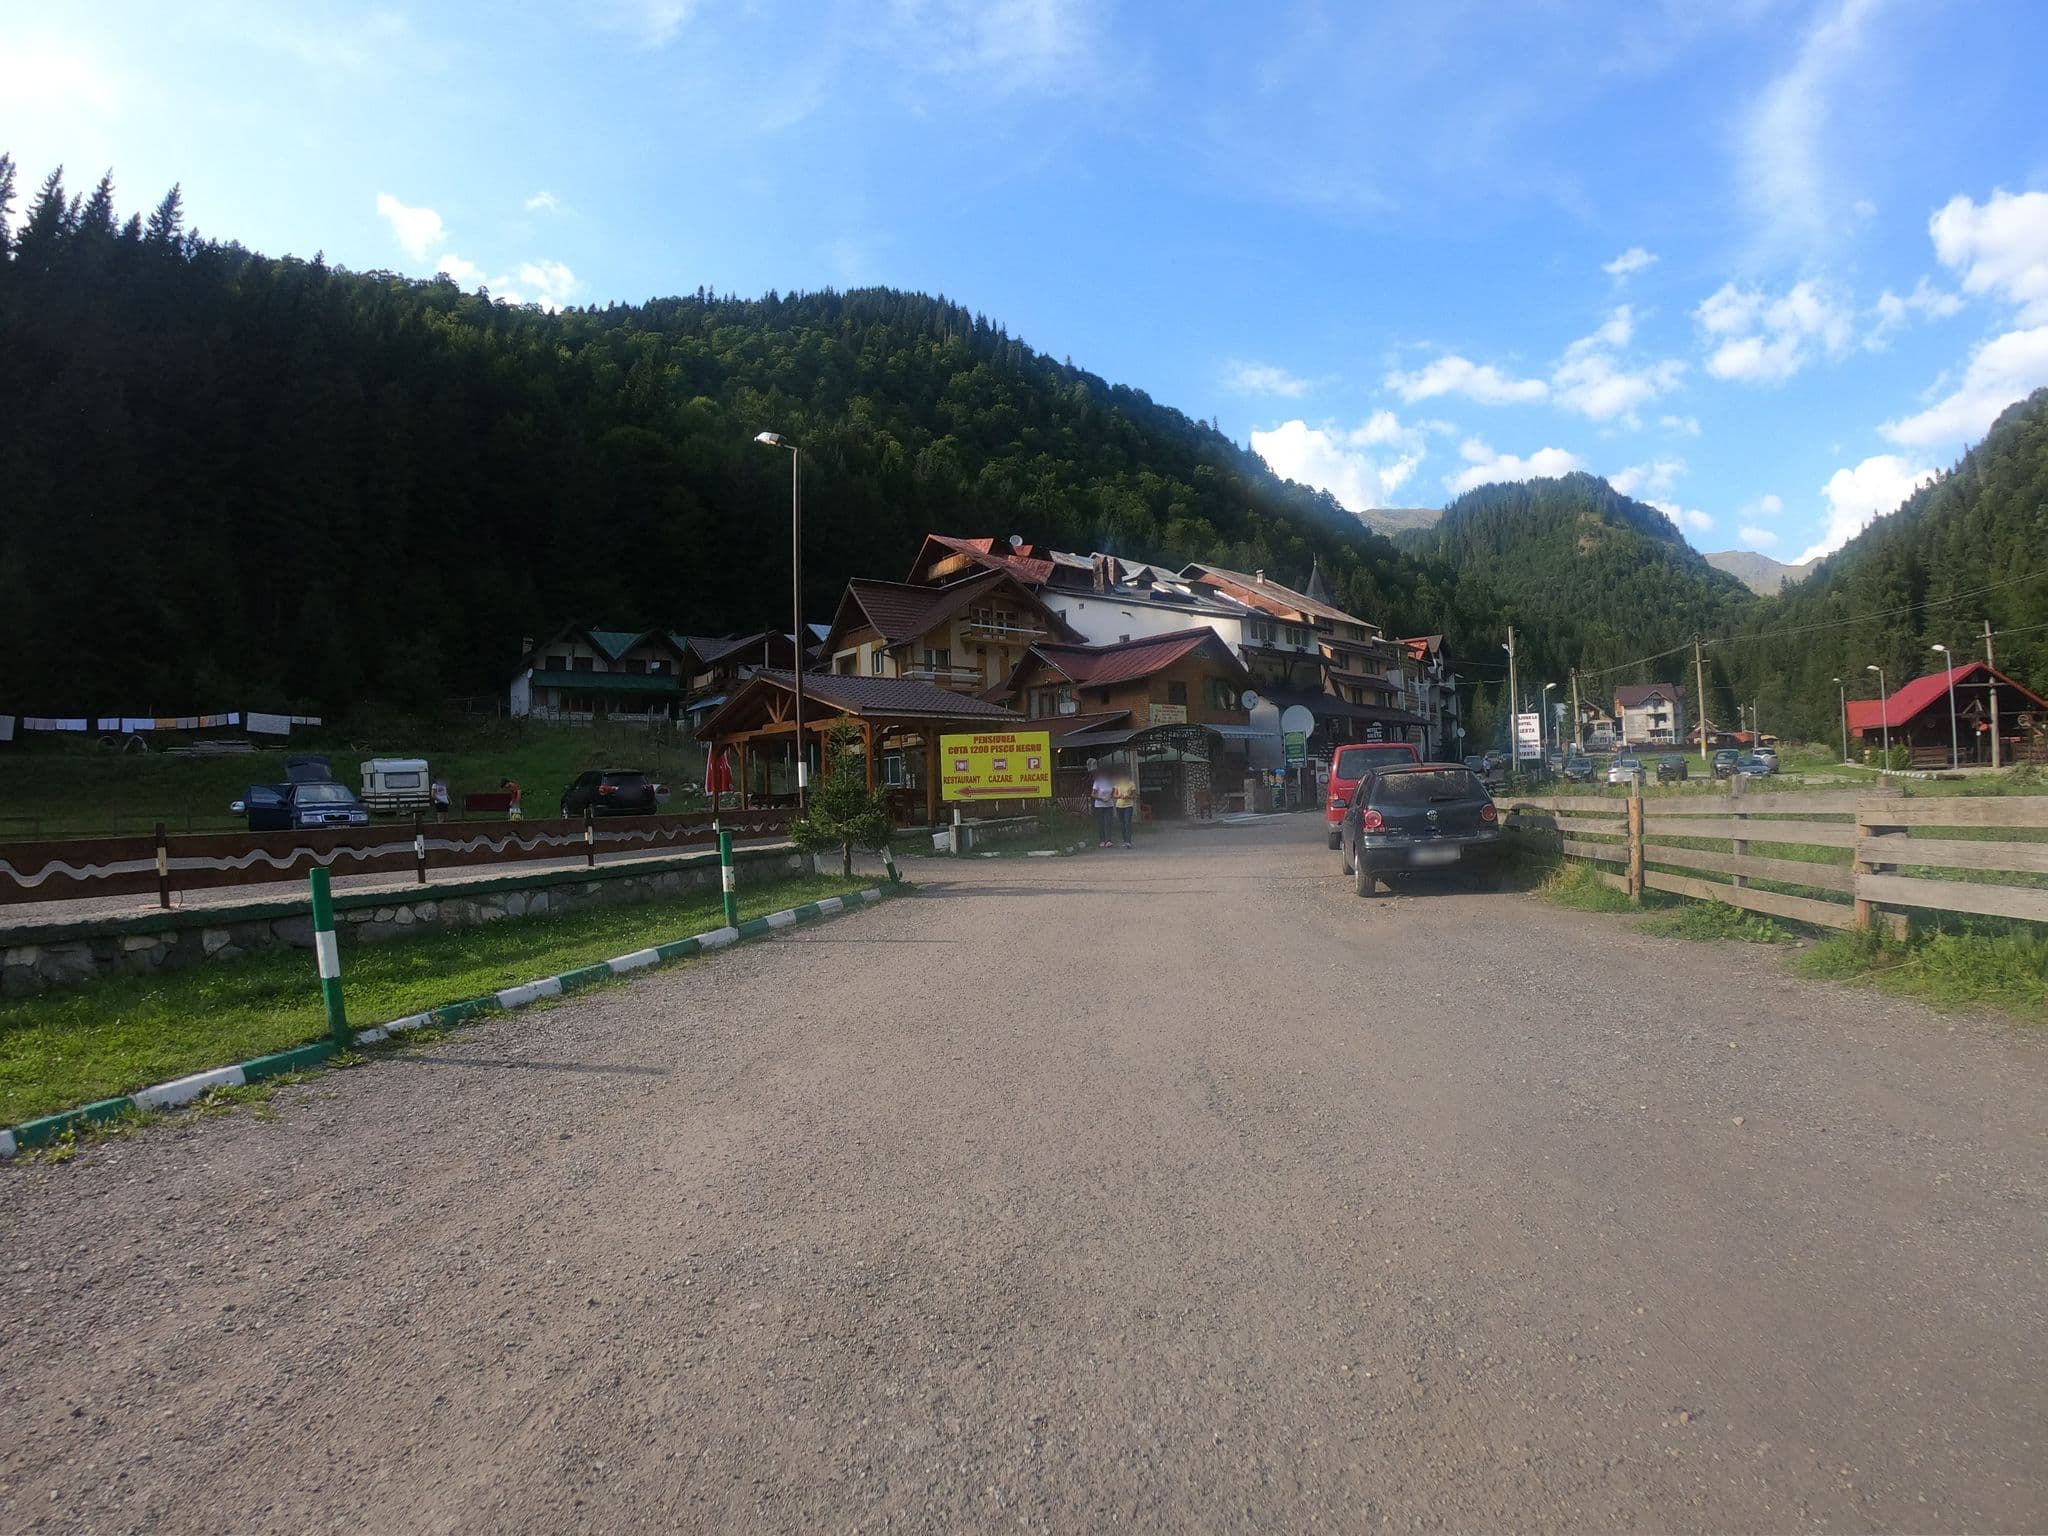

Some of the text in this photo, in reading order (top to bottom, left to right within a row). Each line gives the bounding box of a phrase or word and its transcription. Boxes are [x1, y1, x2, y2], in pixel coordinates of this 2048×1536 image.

[973, 735, 1016, 744] PENSIUNEA
[948, 746, 968, 755] COTA
[971, 745, 989, 754] 1200
[1030, 758, 1039, 768] P
[943, 773, 1049, 785] RESTAURANT CAZARE PARCARE
